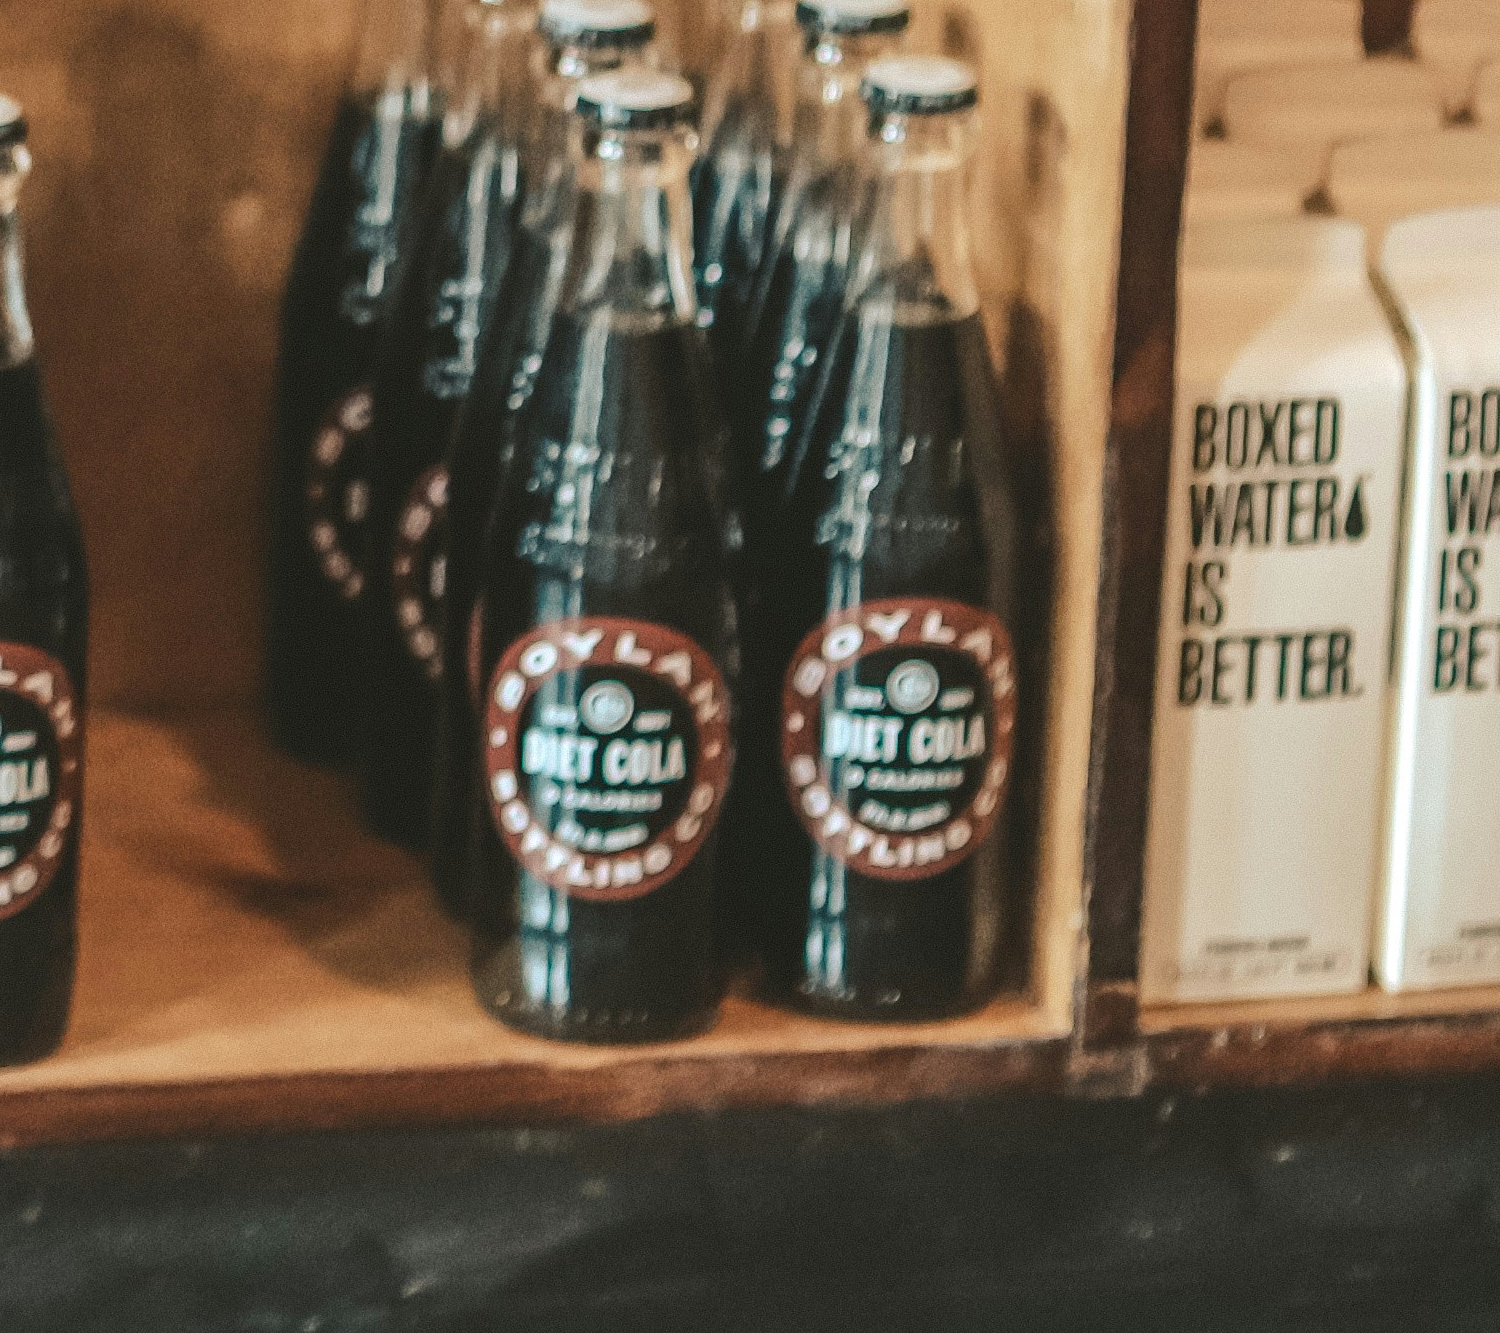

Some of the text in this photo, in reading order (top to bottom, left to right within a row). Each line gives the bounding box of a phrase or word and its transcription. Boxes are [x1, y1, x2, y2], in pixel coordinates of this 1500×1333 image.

[1192, 396, 1340, 472] BOXED
[1189, 476, 1340, 549] WATER
[1182, 559, 1226, 627] IS
[1438, 546, 1481, 616] IS
[1177, 627, 1364, 707] BETTER.
[521, 729, 687, 786] DIET COLA
[821, 710, 986, 764] DIET COLA
